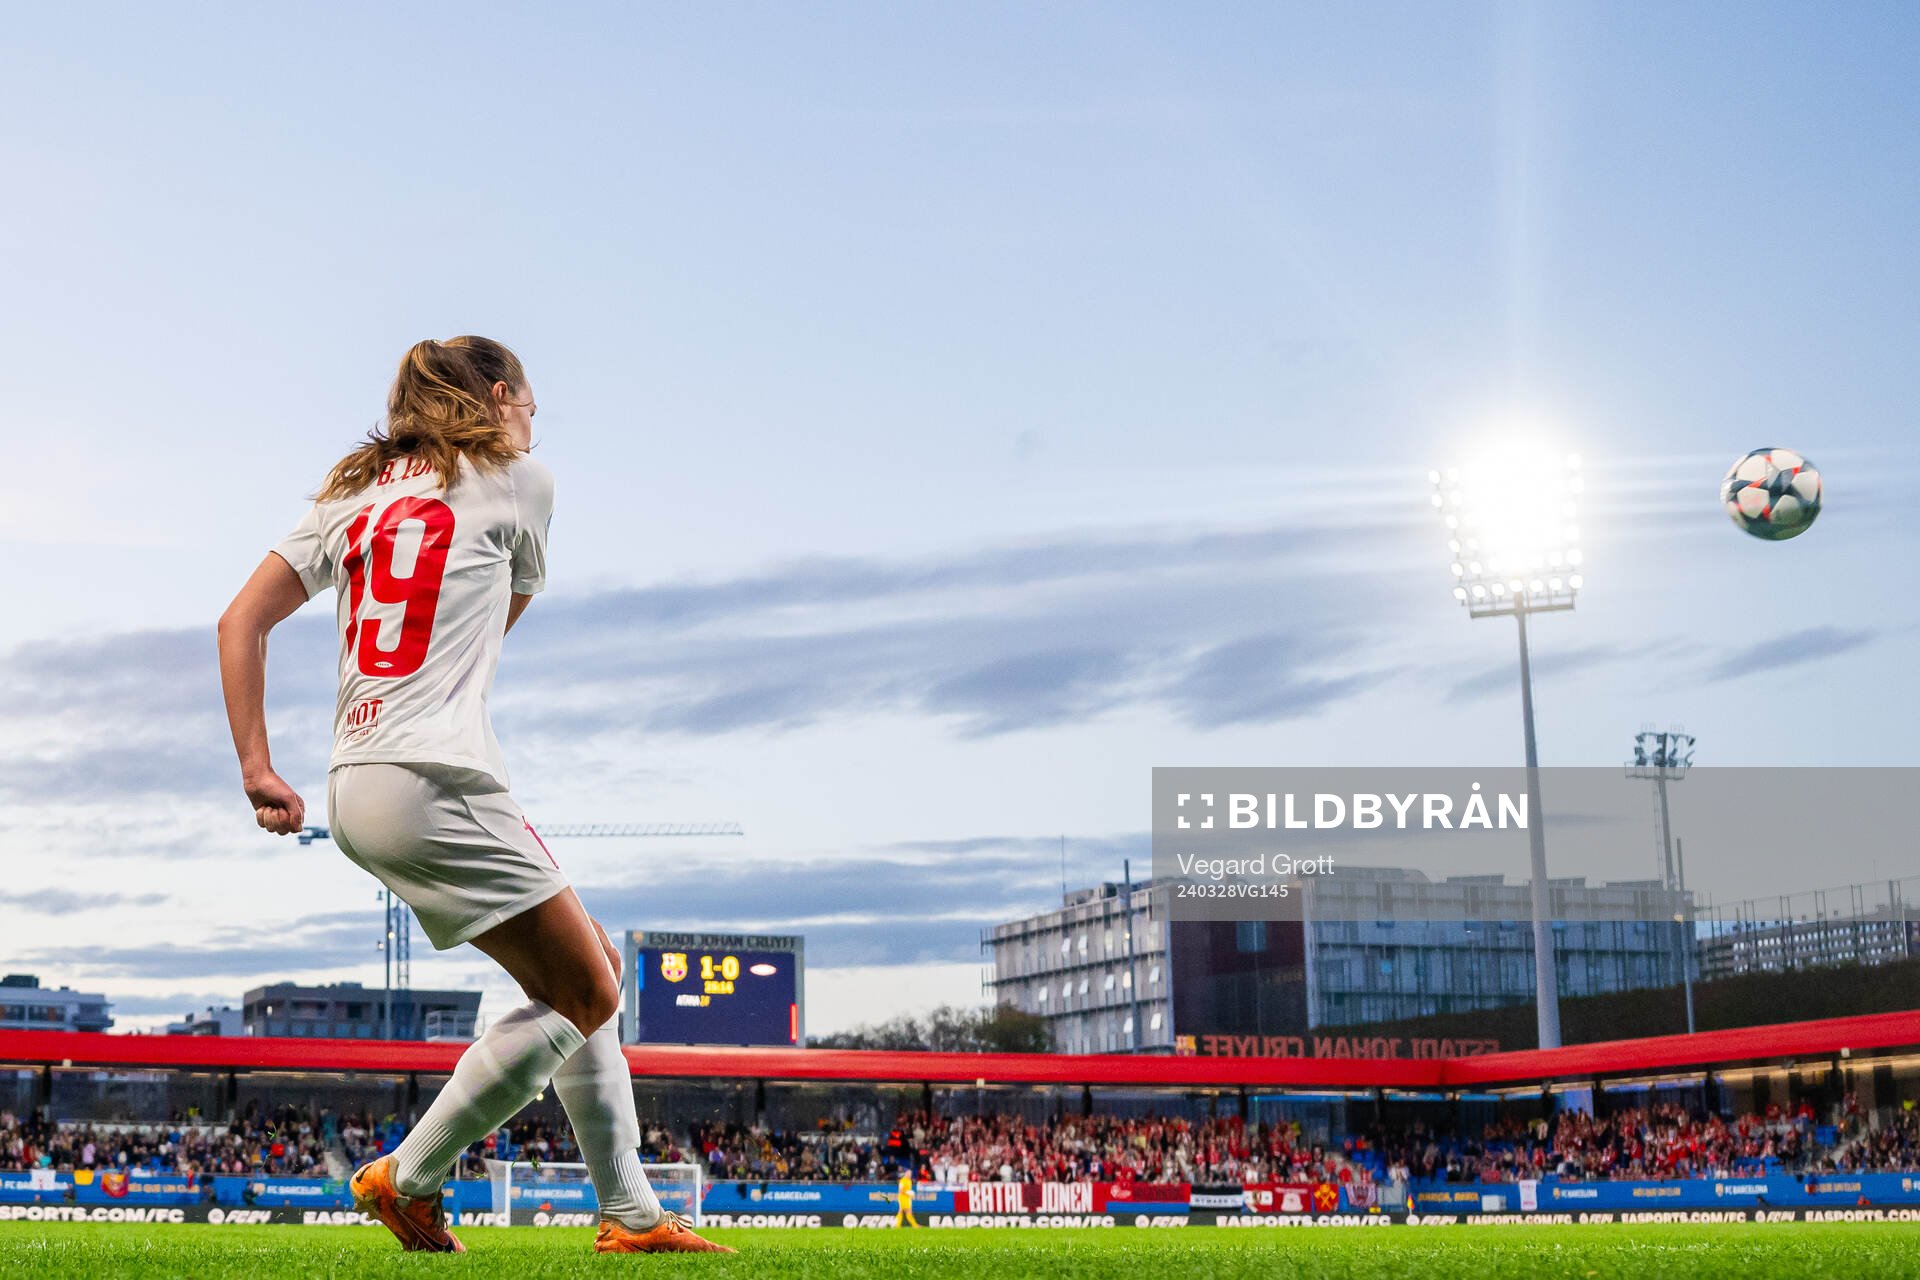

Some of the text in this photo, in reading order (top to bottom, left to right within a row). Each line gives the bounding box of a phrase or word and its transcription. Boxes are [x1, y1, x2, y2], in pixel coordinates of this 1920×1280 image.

[343, 496, 455, 677] 19
[700, 934, 743, 946] JOHAN
[700, 955, 740, 980] 1-0
[969, 1182, 1029, 1213] BATAL
[1036, 1182, 1093, 1213] JONEN
